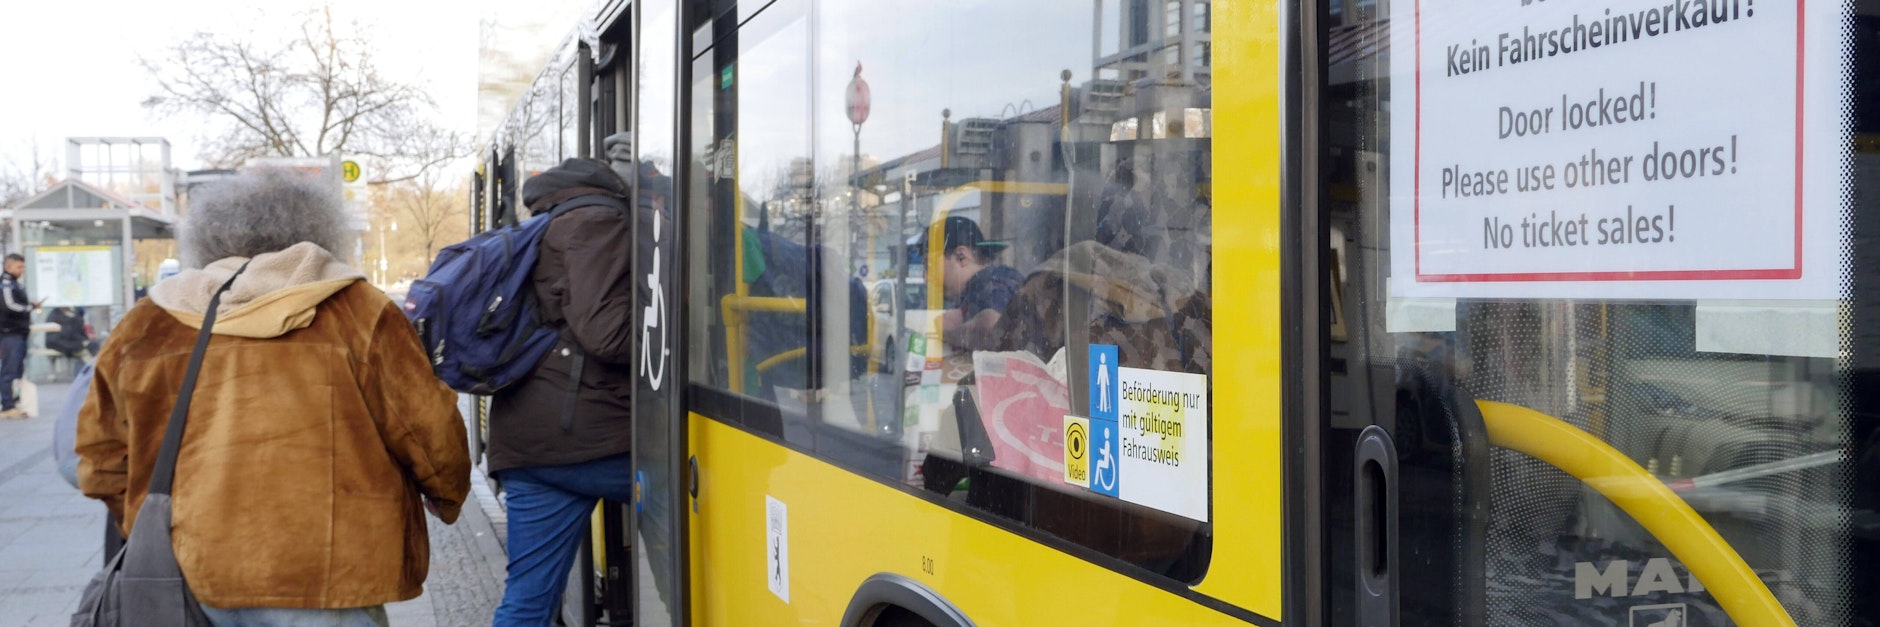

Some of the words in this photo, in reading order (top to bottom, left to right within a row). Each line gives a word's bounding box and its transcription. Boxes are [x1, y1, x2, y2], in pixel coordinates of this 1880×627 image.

[1446, 38, 1490, 77] Kein
[1498, 105, 1554, 139] Door
[1561, 80, 1657, 131] locked!
[1441, 164, 1509, 199] Please
[1516, 162, 1556, 192] use
[1563, 148, 1634, 189] other
[1642, 134, 1738, 182] doors!
[1483, 215, 1513, 250] No
[1520, 209, 1589, 248] ticket
[1596, 204, 1675, 246] sales!
[1122, 380, 1180, 413] Beförderung
[1183, 391, 1200, 410] nur
[1122, 408, 1137, 430] mit
[1140, 410, 1182, 441] gültigem
[1123, 437, 1180, 467] Fahrausweis
[1067, 463, 1087, 481] Video
[1575, 557, 1706, 600] MA
